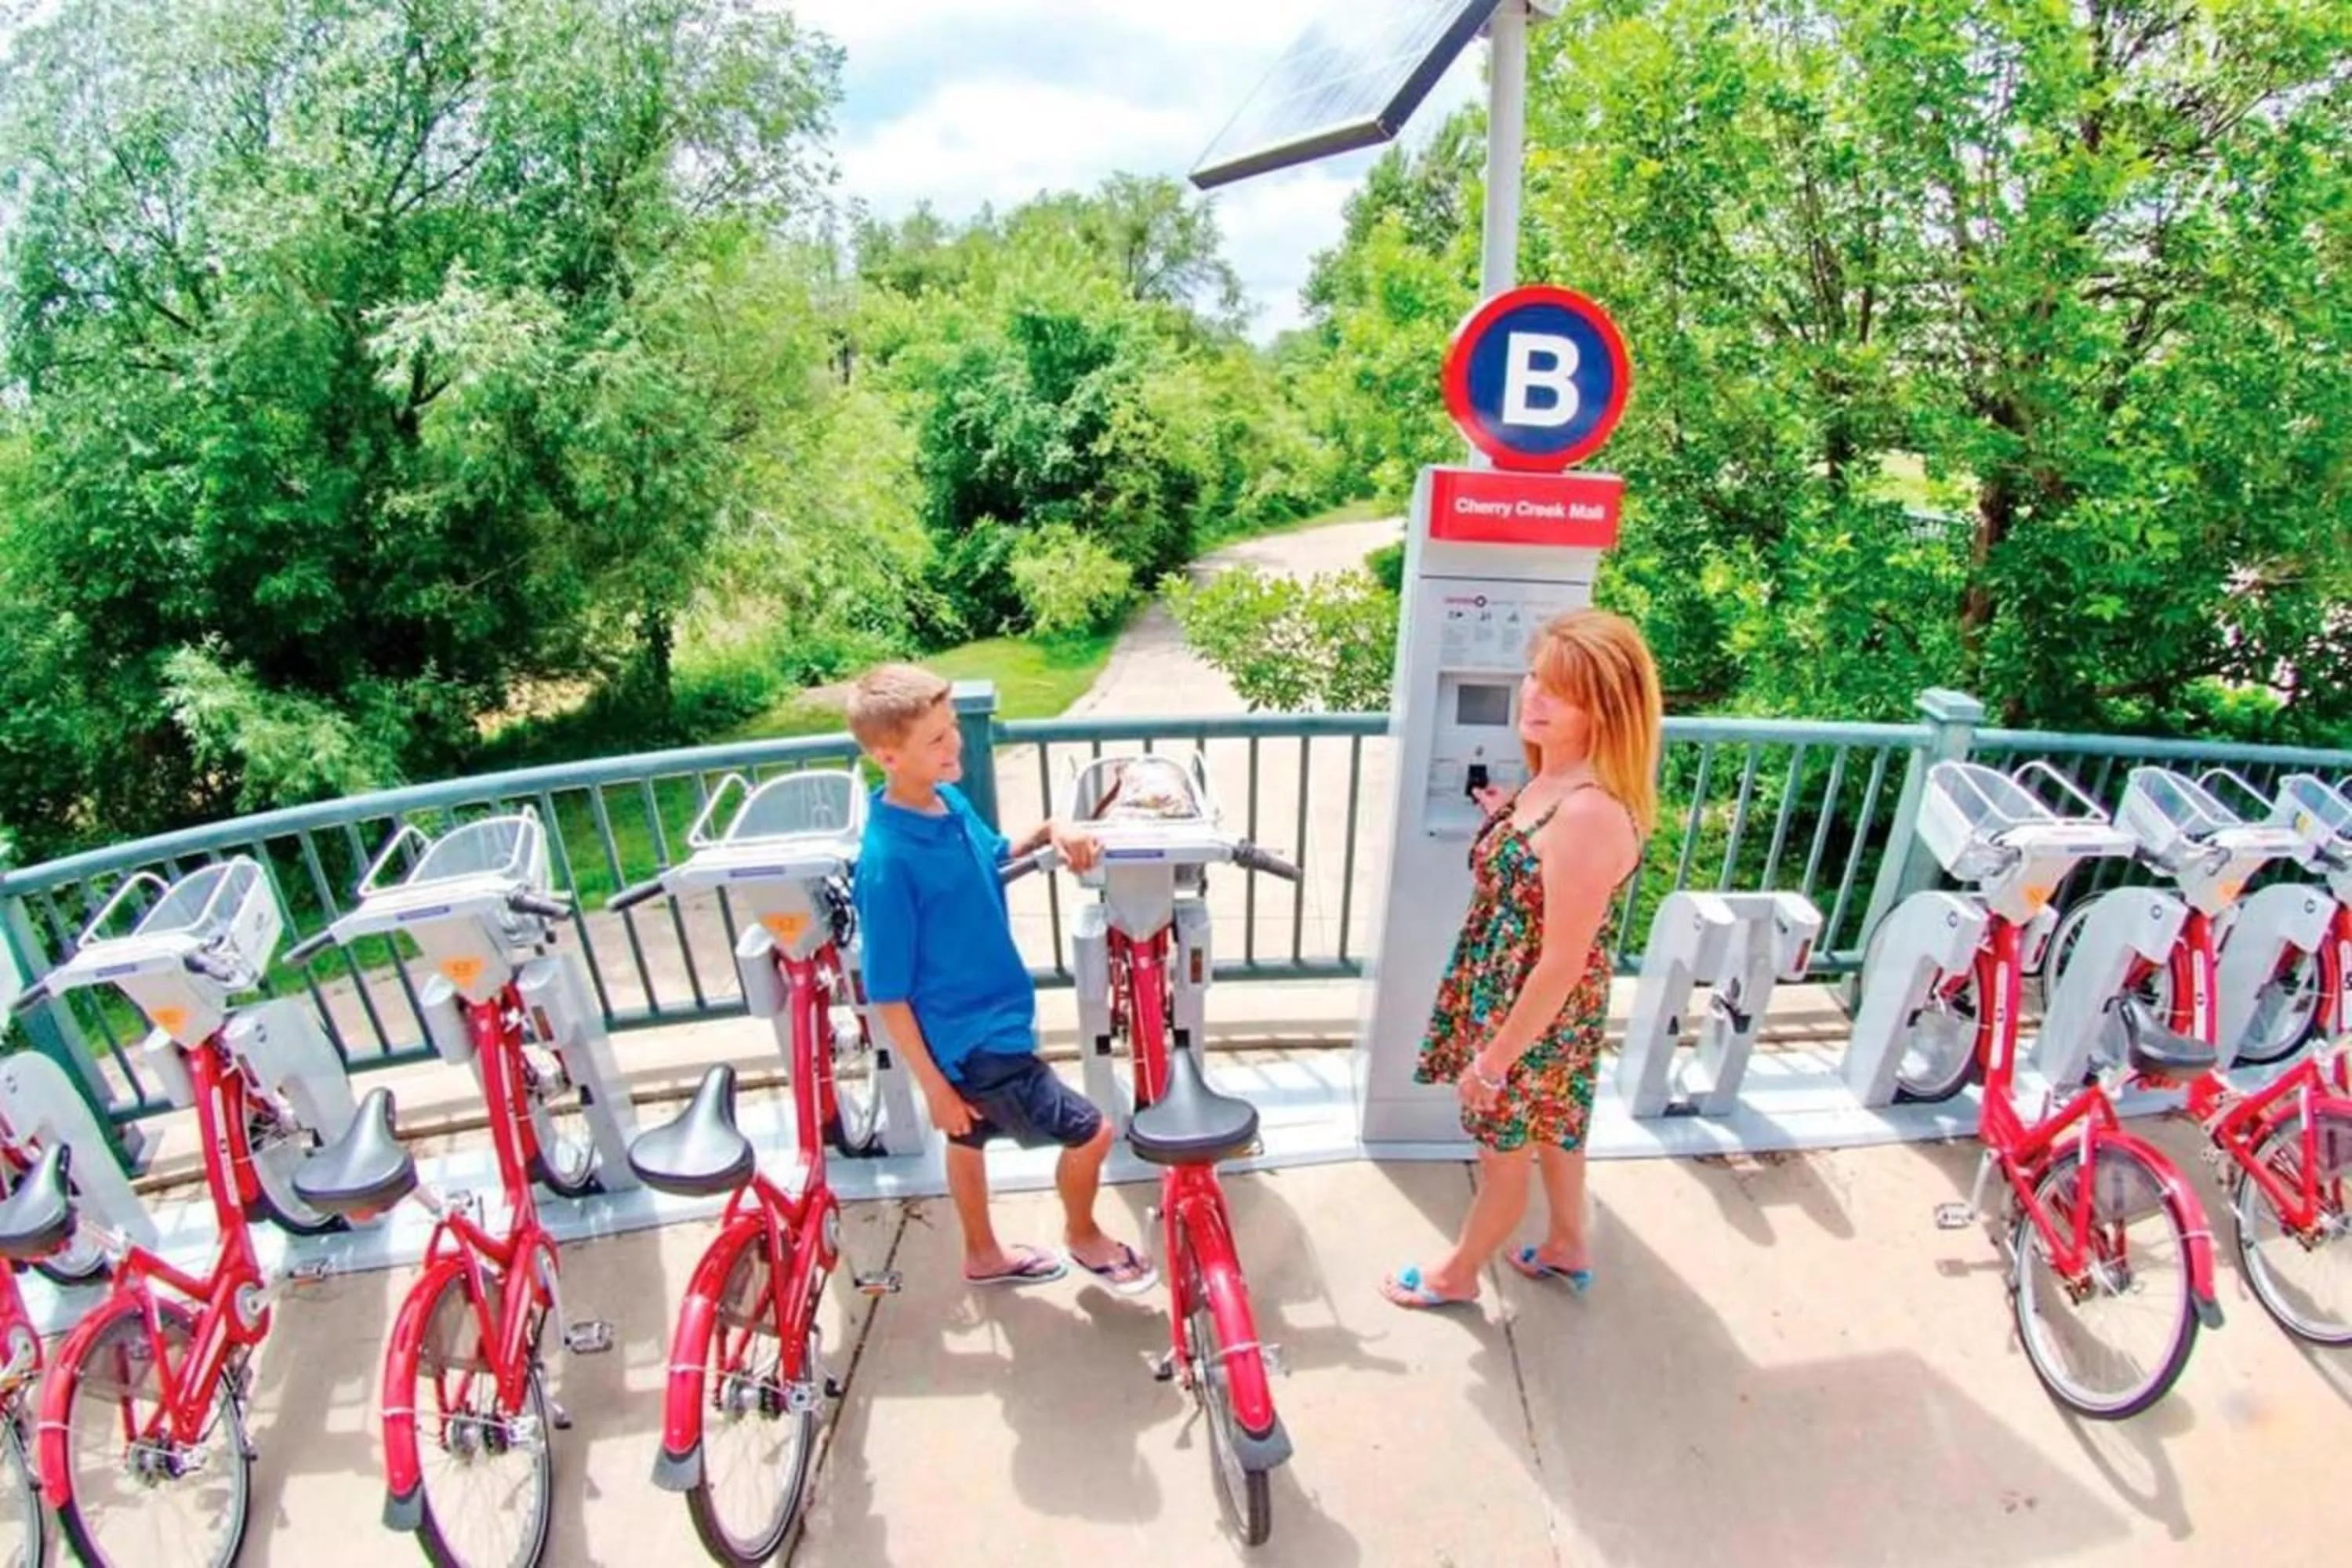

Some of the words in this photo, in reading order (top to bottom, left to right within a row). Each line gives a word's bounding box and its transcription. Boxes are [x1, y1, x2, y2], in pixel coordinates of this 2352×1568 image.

[1502, 330, 1580, 427] B
[1455, 496, 1513, 519] Cherry
[1515, 499, 1565, 518] Creek
[1569, 503, 1605, 521] Mall
